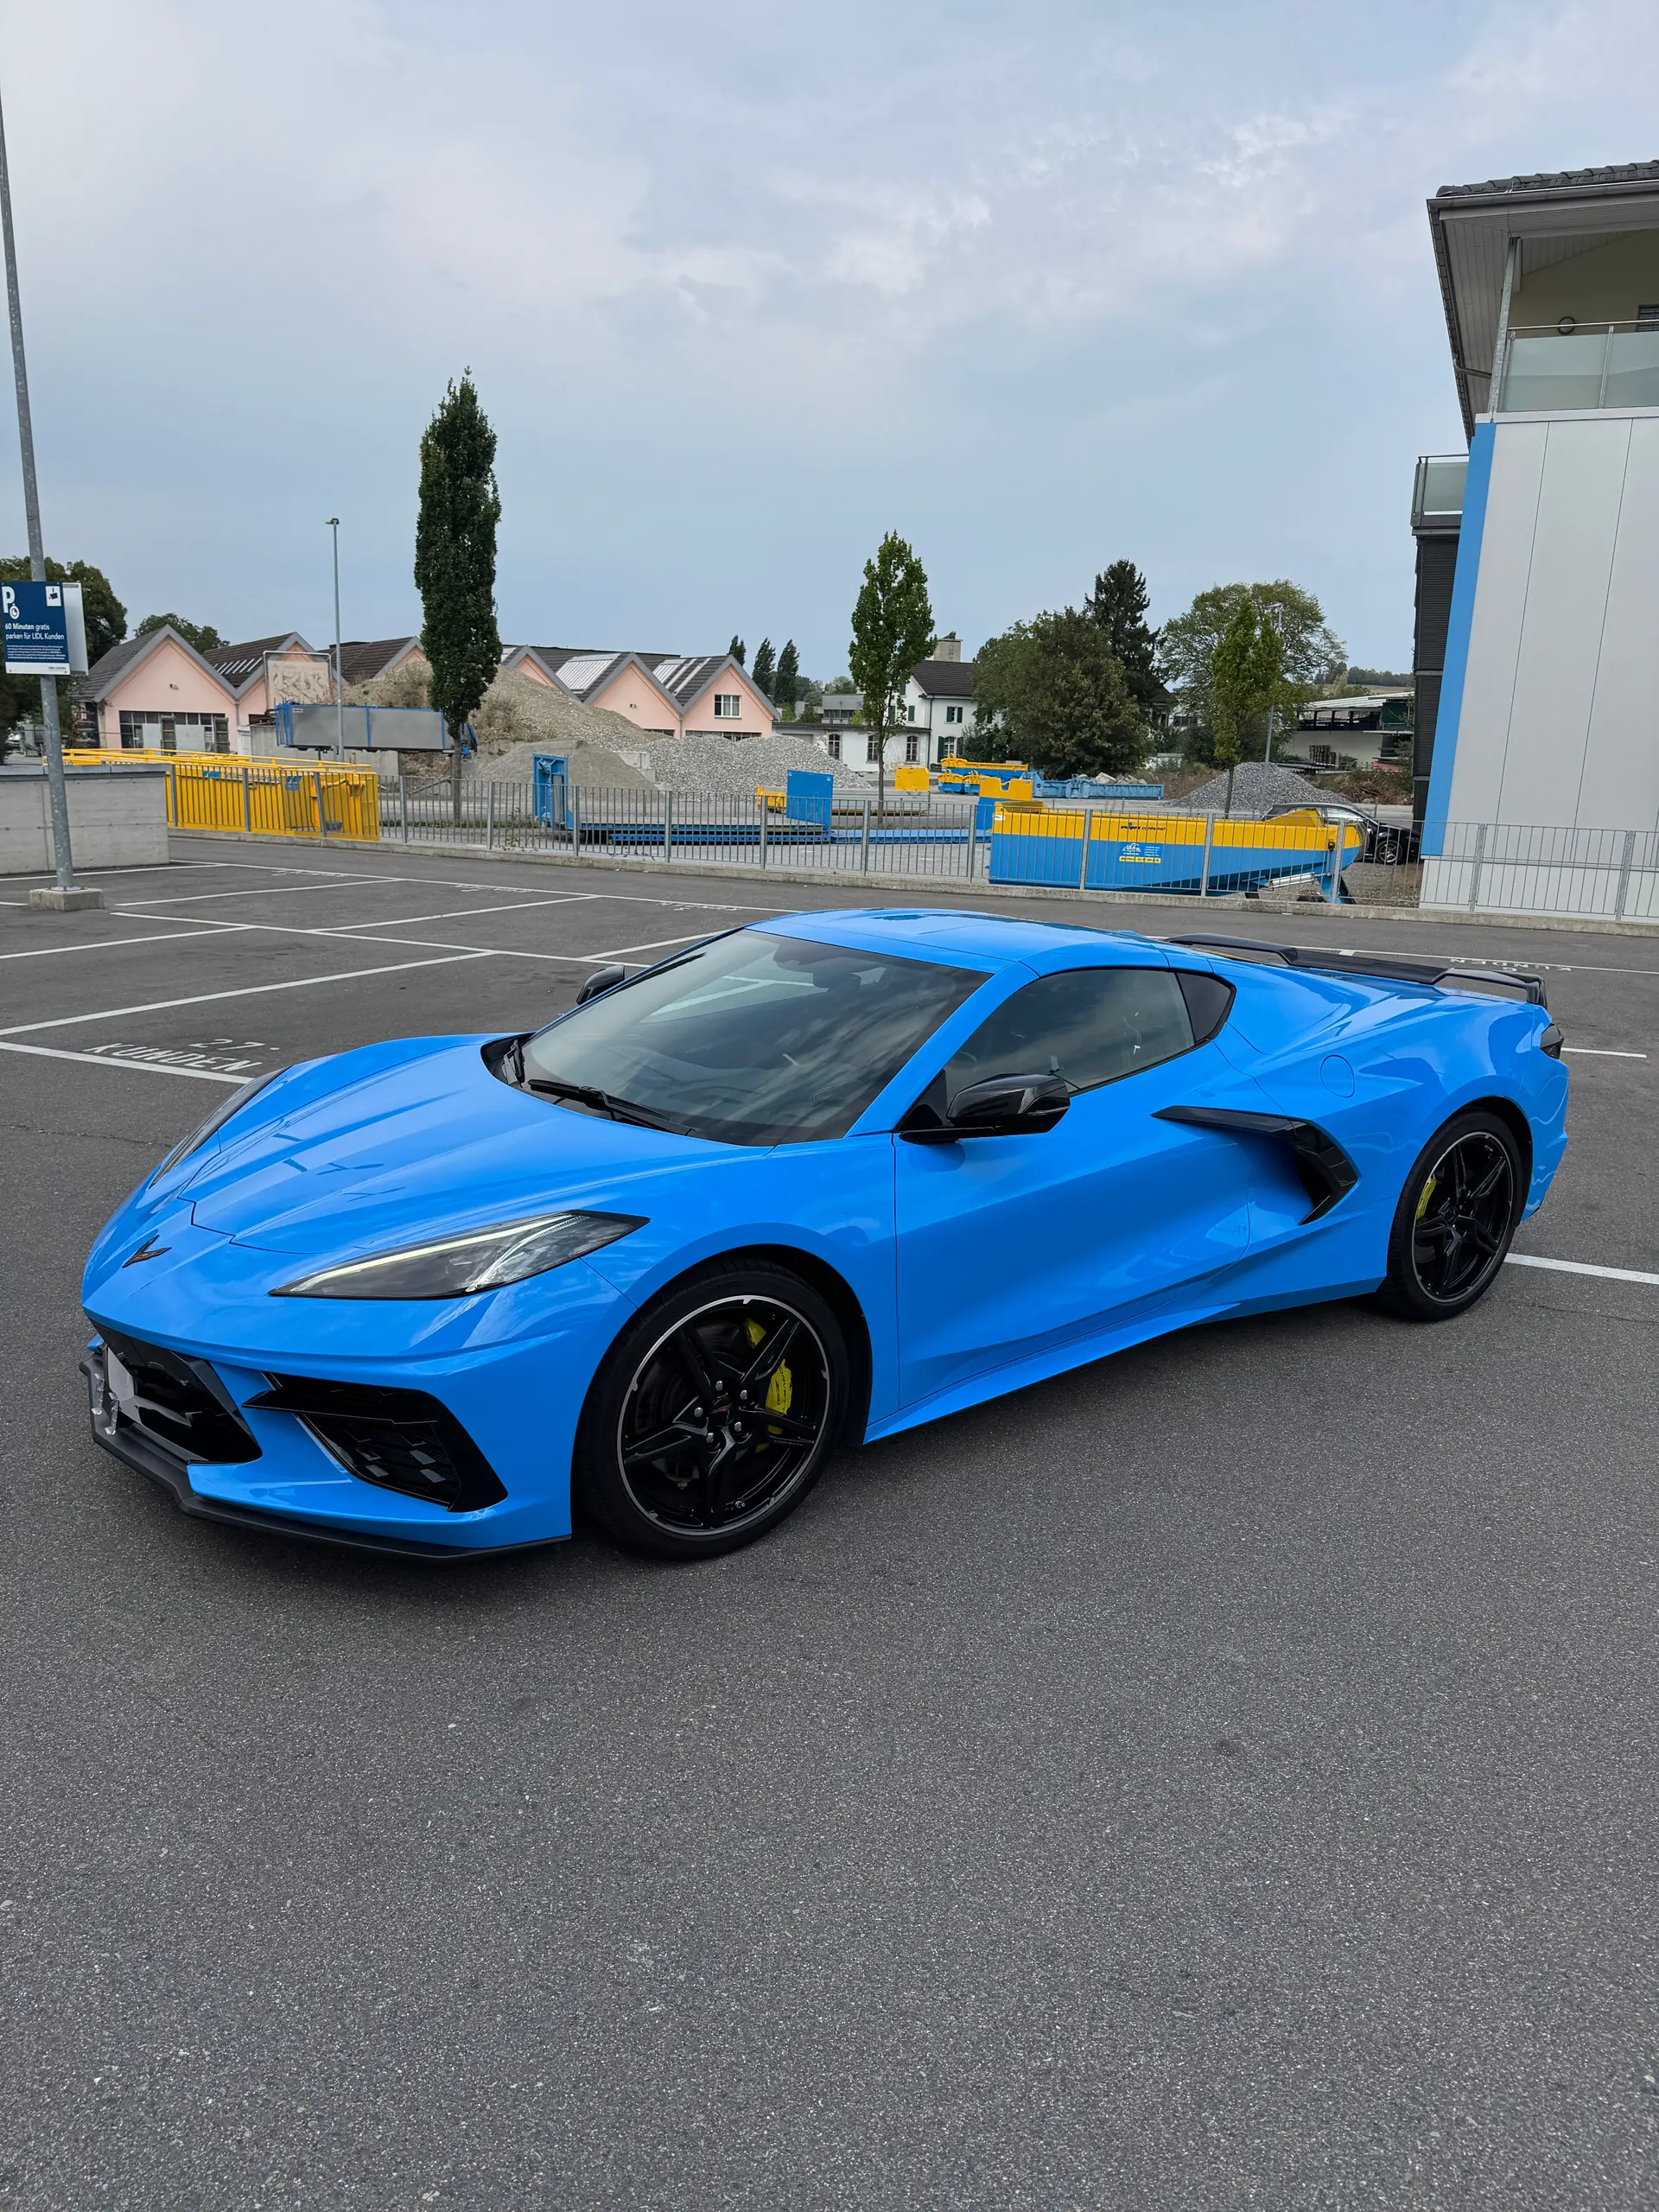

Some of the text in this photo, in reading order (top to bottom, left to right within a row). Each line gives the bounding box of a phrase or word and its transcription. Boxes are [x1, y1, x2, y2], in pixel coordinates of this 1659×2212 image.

[2, 586, 16, 613] P
[5, 632, 23, 640] parken
[35, 623, 50, 632] gratis
[82, 1042, 263, 1072] KUNDEN
